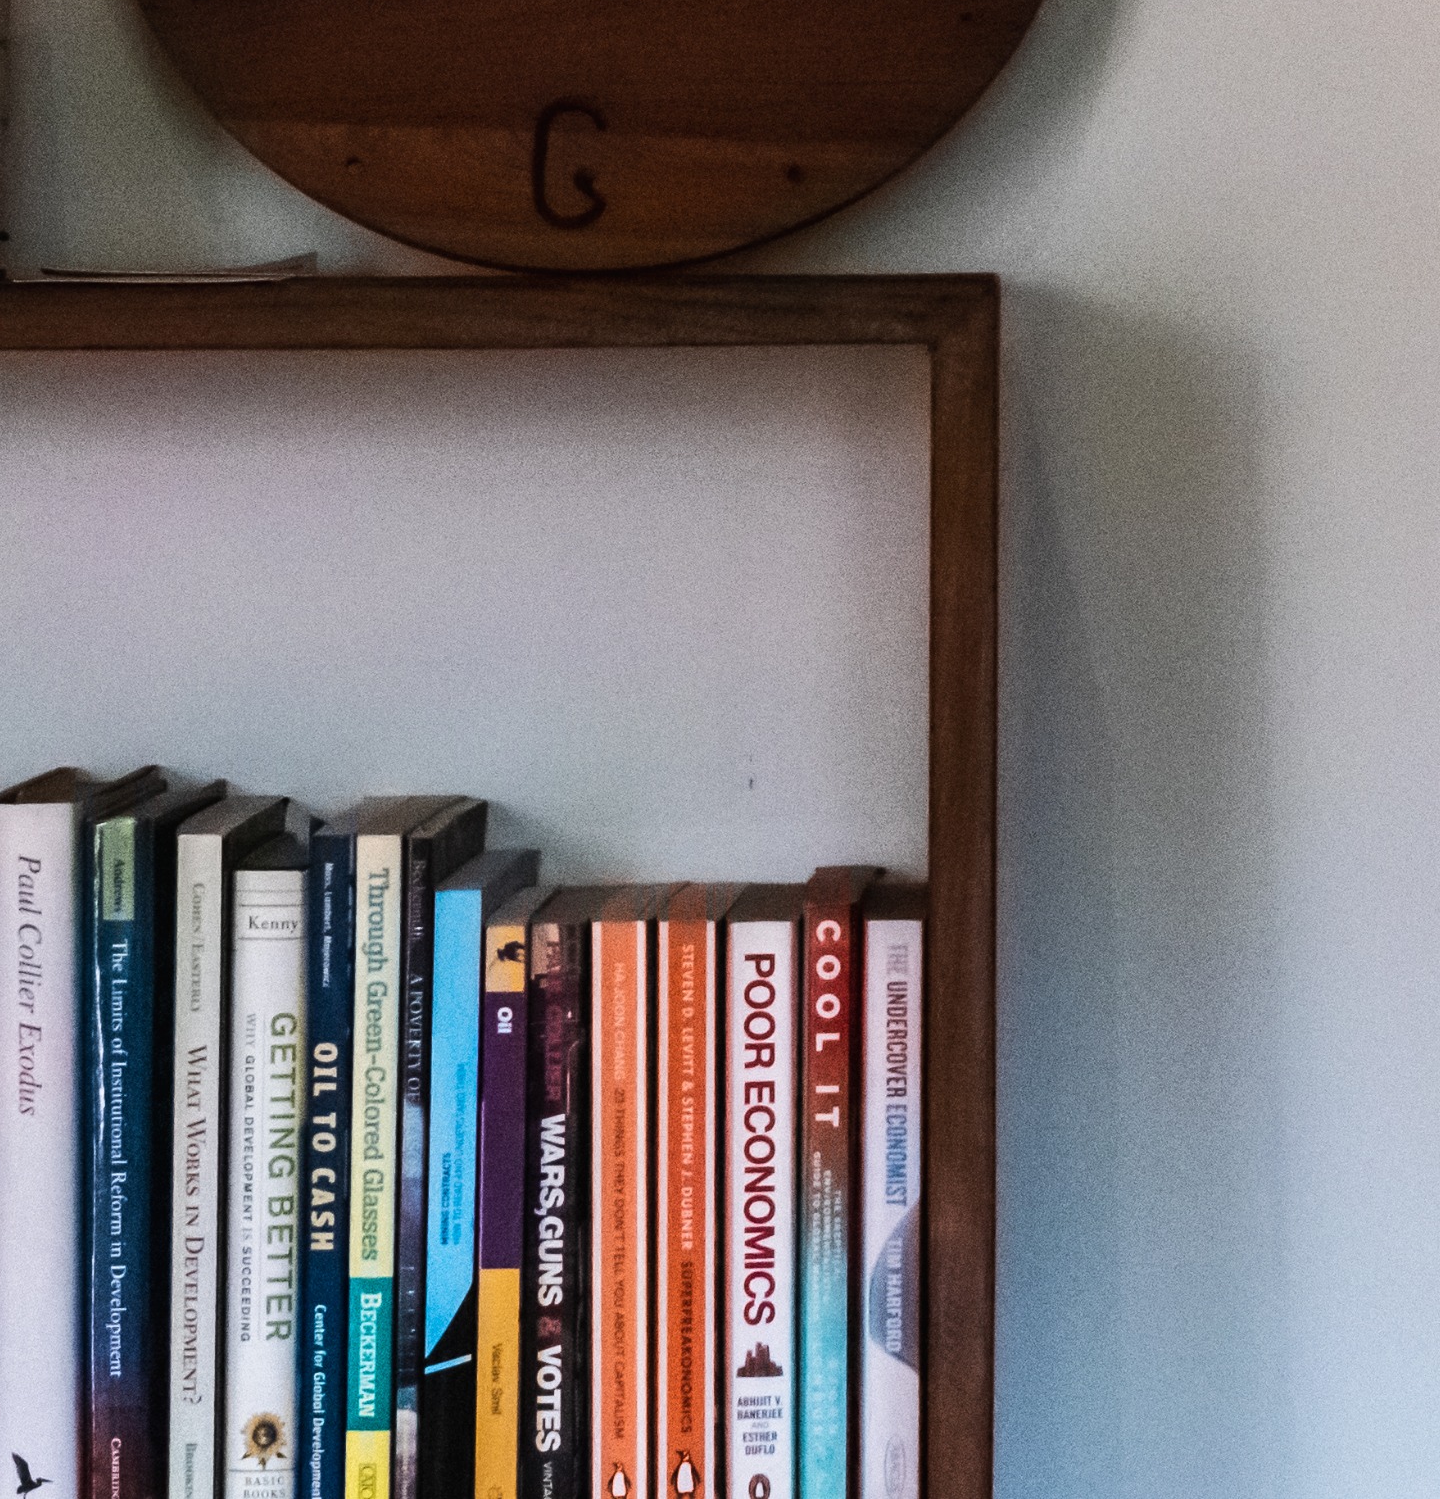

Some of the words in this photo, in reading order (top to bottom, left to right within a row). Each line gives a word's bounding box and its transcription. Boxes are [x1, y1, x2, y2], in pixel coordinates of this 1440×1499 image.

[18, 854, 43, 915] Paul
[248, 914, 300, 934] Kenny
[363, 868, 390, 974] Through
[18, 923, 43, 1014] Collier
[111, 937, 129, 974] The
[681, 944, 695, 1002] STEVEN
[815, 919, 842, 1052] COOL
[111, 977, 129, 1033] Limits
[245, 1012, 257, 1048] WHY
[408, 989, 424, 1078] POVERTY
[497, 1006, 513, 1034] Oil
[743, 953, 776, 1069] POOR
[18, 1021, 43, 1117] Exodus
[111, 1036, 128, 1054] of
[313, 1041, 338, 1097] OIL
[362, 979, 389, 1162] Green-Colored
[613, 1031, 626, 1081] CHANG
[681, 1027, 695, 1077] LEVITT
[886, 980, 908, 1099] UNDERCOVER
[110, 1054, 128, 1166] Institutional
[186, 1044, 208, 1115] WHAT
[244, 1054, 257, 1112] GLOBAL
[268, 1012, 298, 1180] GETTING
[815, 1085, 840, 1128] IT
[185, 1117, 207, 1197] WORKS
[312, 1112, 337, 1153] TO
[613, 1108, 626, 1157] THINGS
[680, 1096, 695, 1166] STEPHEN
[885, 1104, 908, 1207] ECONOMIST
[242, 1116, 256, 1222] DEVELOPMENT
[440, 1152, 453, 1210] CONTRACTS
[109, 1171, 128, 1237] Reform
[310, 1167, 337, 1252] CASH
[361, 1165, 384, 1262] Glasses
[680, 1186, 694, 1251] DUBNER
[743, 1080, 776, 1327] ECONOMICS
[109, 1240, 127, 1259] in
[265, 1195, 295, 1342] BETTER
[886, 1238, 904, 1268] TIM
[106, 1264, 128, 1379] Development
[182, 1236, 206, 1406] DEVELOPMENT?
[240, 1247, 253, 1343] SUCCEEDING
[314, 1304, 327, 1347] Center
[613, 1279, 626, 1308] YOU
[885, 1273, 903, 1352] HARFORD
[358, 1292, 383, 1419] BECKERMAN
[613, 1312, 626, 1357] ABOUT
[680, 1260, 694, 1434] SUPERFREAKONOMICS
[312, 1370, 326, 1411] Global
[536, 1344, 563, 1453] VOTES
[612, 1361, 626, 1440] CAPITALISM
[736, 1395, 772, 1407] ABHIJIT
[736, 1408, 784, 1420] BANERJEE
[742, 1431, 778, 1443] ESTHER
[744, 1444, 776, 1456] DUFLO
